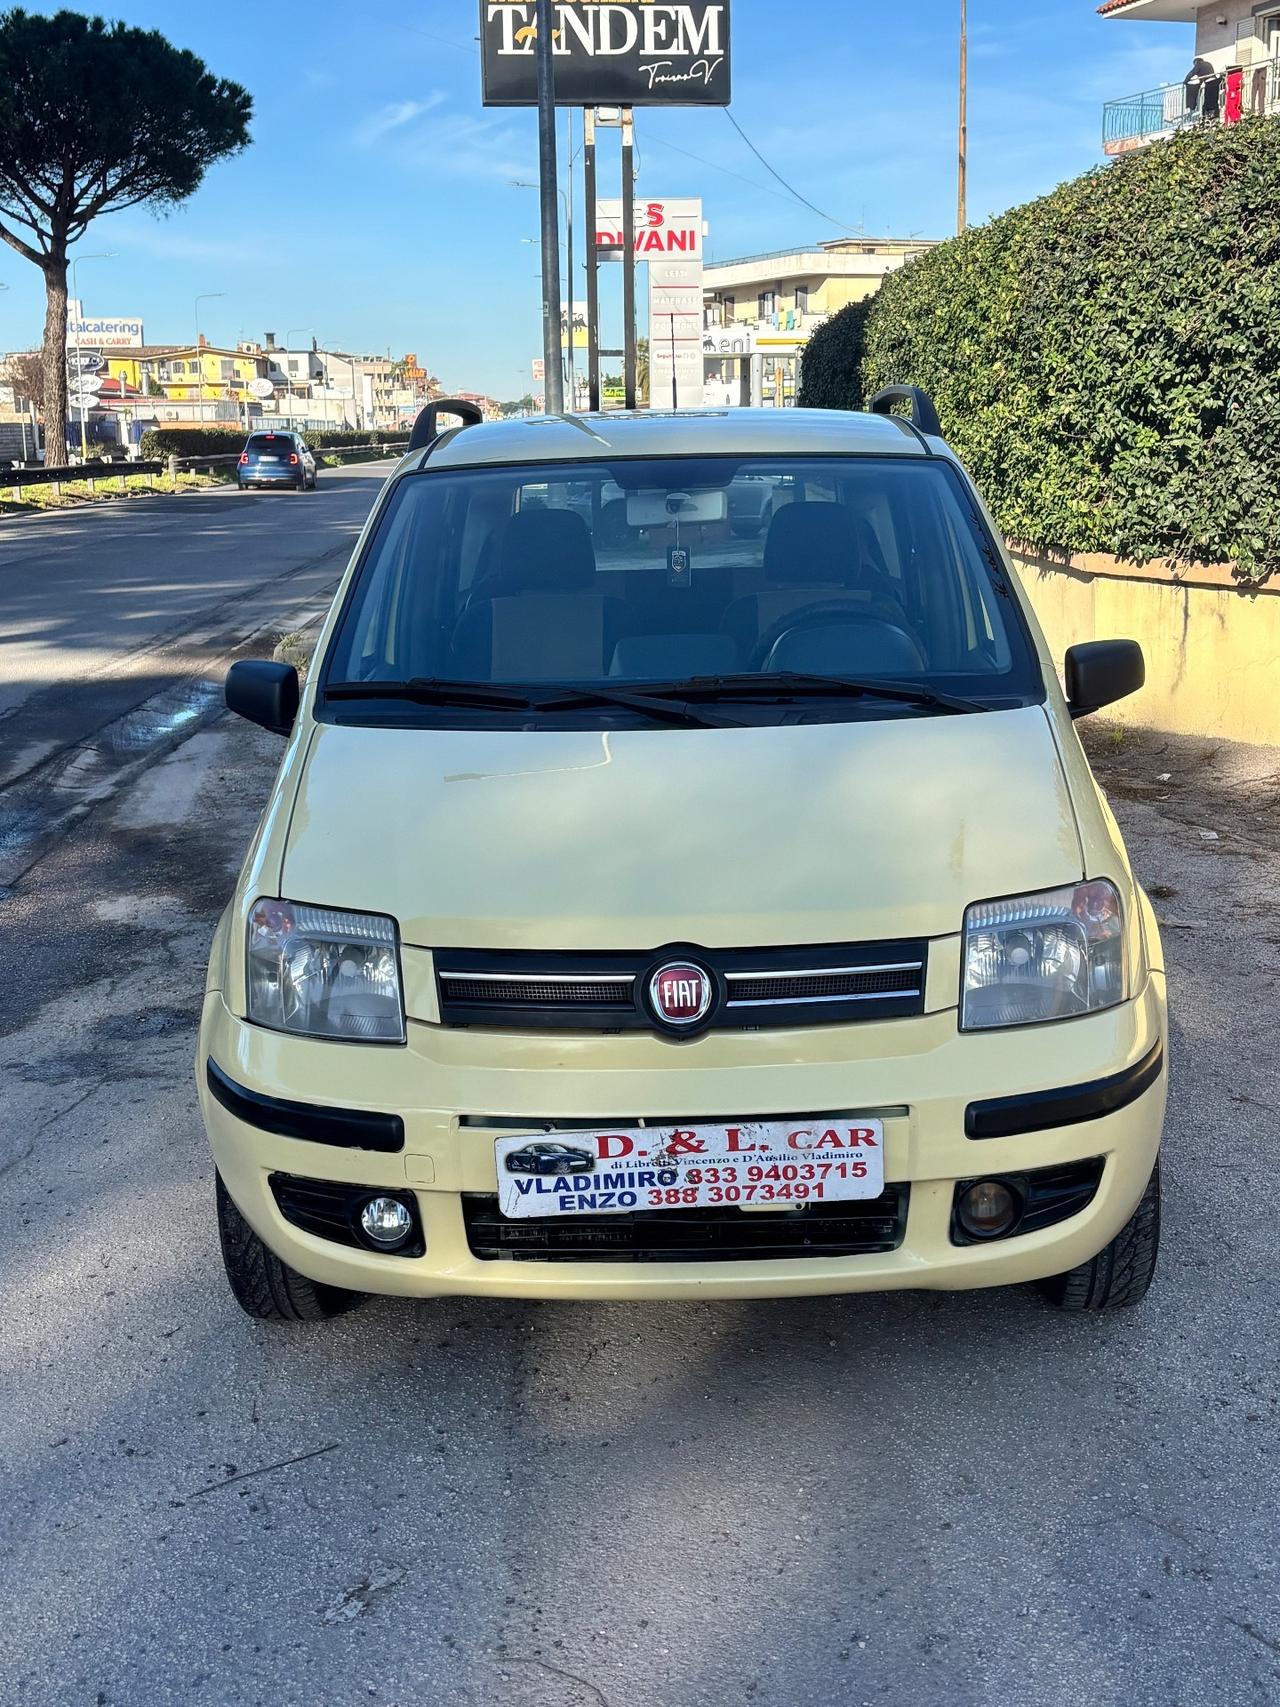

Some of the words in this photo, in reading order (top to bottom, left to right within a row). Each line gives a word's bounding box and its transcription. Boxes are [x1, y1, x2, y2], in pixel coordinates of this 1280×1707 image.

[106, 337, 132, 346] CARRY
[719, 332, 750, 352] eni
[663, 979, 699, 1008] FIAT
[595, 1135, 649, 1160] D.
[665, 1130, 709, 1155] &
[725, 1128, 770, 1153] L.
[787, 1128, 879, 1150] CAR
[611, 1161, 623, 1170] di
[674, 1156, 730, 1168] Vincenzo
[801, 1151, 863, 1161] Vladimiro
[514, 1169, 678, 1195] VLADIMIRO
[747, 1161, 868, 1183] 9403715
[558, 1191, 638, 1212] ENZO
[647, 1187, 699, 1206] 388
[707, 1181, 825, 1203] 3073491
